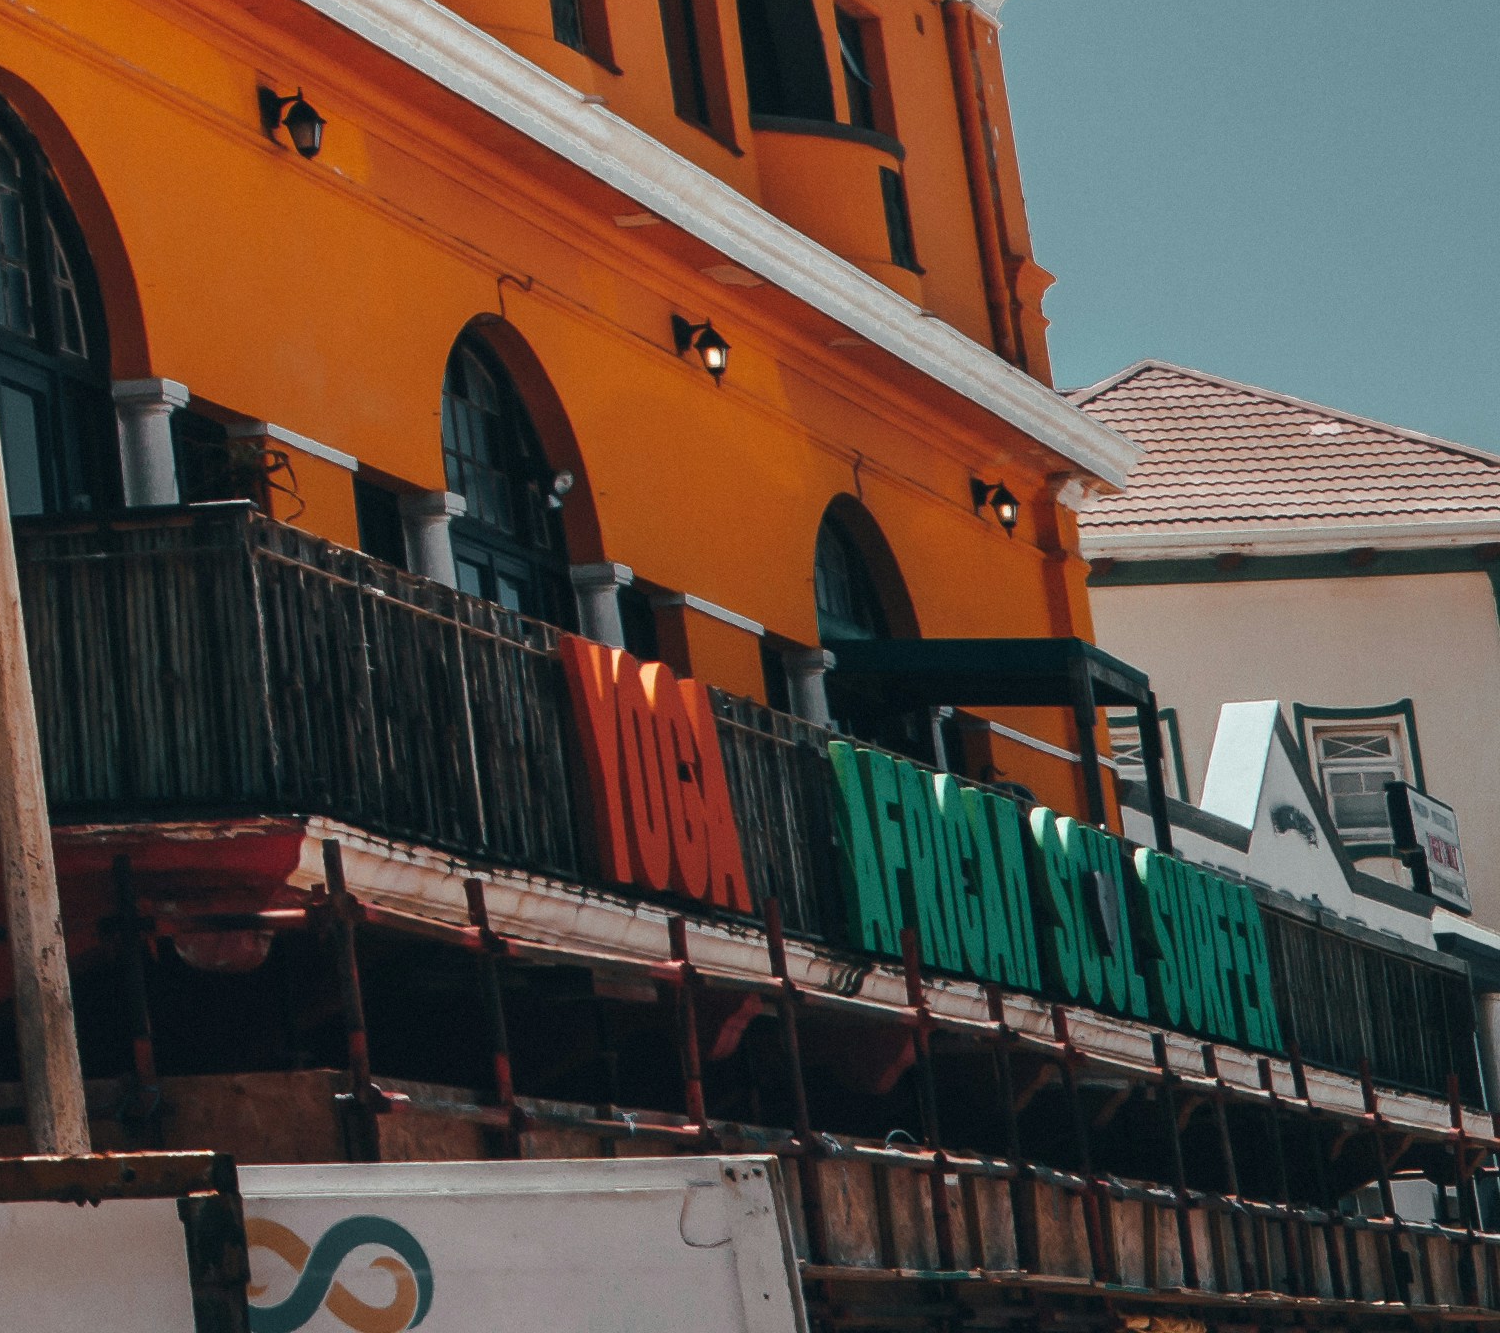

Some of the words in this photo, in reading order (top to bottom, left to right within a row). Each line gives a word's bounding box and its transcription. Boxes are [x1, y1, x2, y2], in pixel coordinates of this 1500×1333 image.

[561, 634, 753, 914] YOGA
[828, 740, 1042, 992] AFRICAN
[1134, 847, 1284, 1055] SURFER
